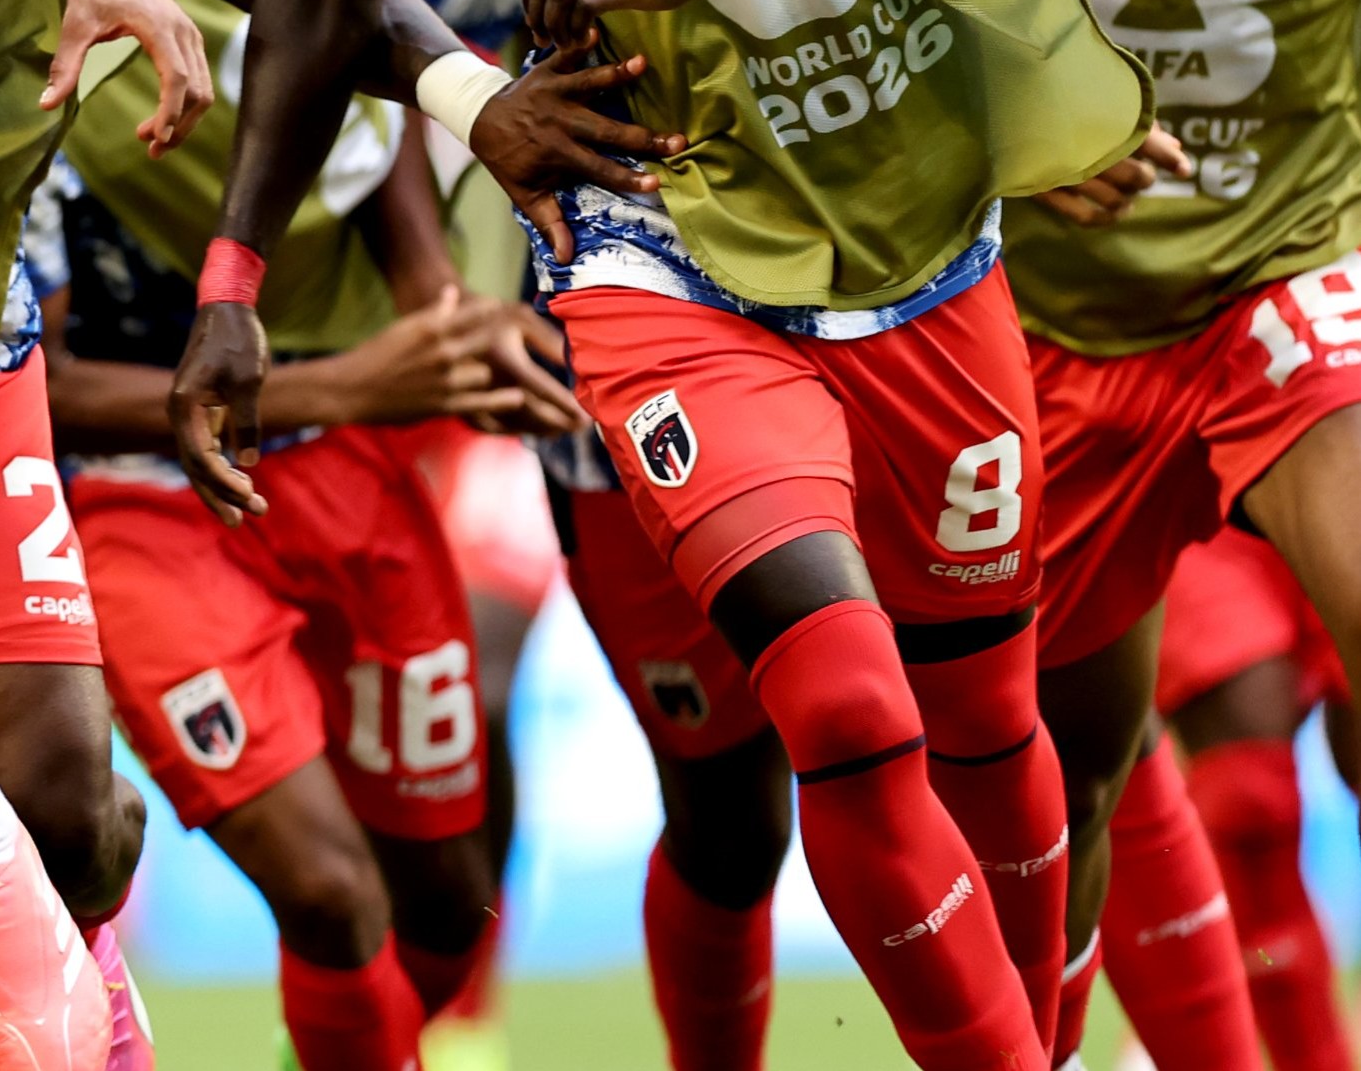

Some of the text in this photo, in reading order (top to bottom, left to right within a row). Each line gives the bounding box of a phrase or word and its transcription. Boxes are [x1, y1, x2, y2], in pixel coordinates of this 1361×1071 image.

[743, 24, 872, 89] WORLD
[758, 9, 953, 148] 2026
[631, 393, 670, 435] FCF
[2, 455, 87, 587] 2
[935, 430, 1022, 552] 8
[928, 549, 1021, 583] capelli
[968, 571, 1018, 585] SPORT
[345, 638, 478, 775] 16
[882, 872, 974, 946] capelli
